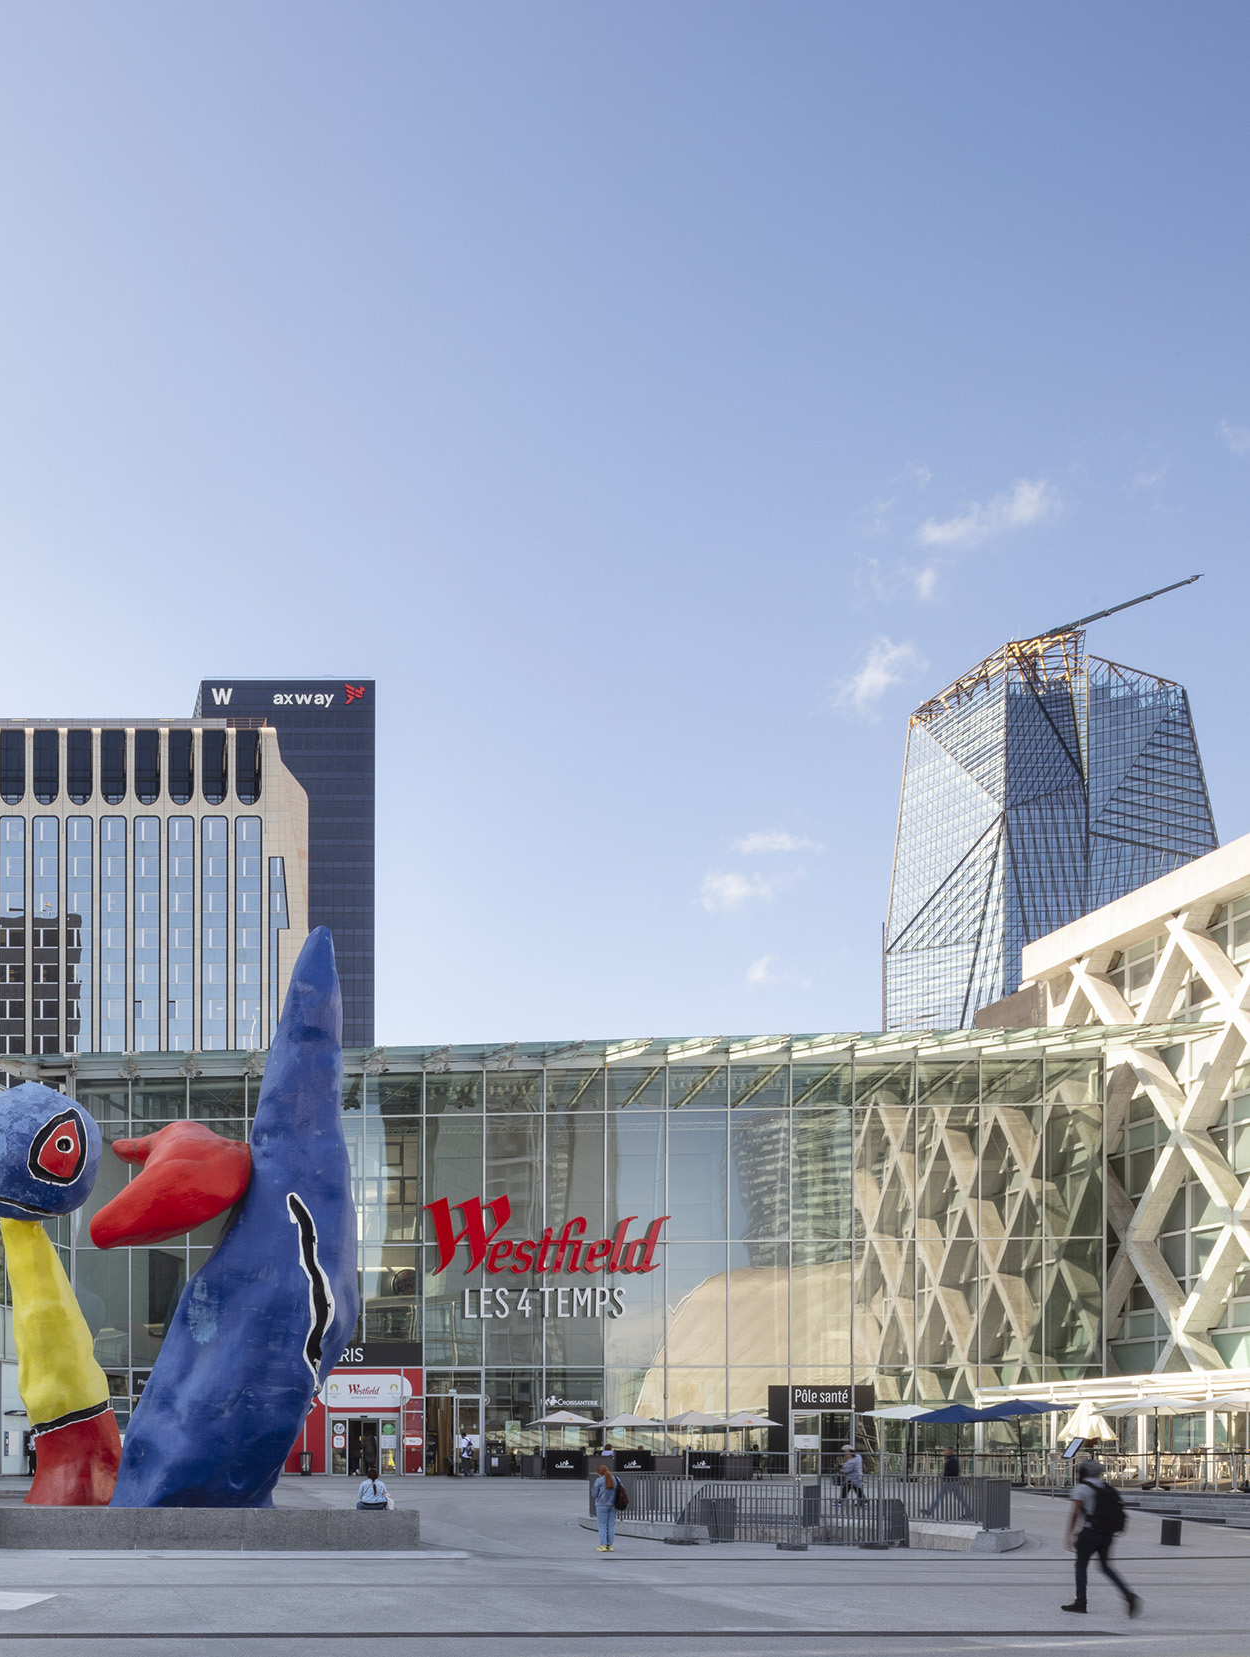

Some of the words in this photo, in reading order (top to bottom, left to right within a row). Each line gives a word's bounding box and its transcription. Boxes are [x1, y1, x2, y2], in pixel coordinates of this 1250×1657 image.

[211, 687, 233, 706] W
[273, 693, 334, 708] axway
[422, 1194, 671, 1274] Westfield
[465, 1288, 510, 1318] LES
[517, 1287, 532, 1318] 4
[539, 1287, 627, 1319] TEMPS
[338, 1347, 364, 1362] RIS
[348, 1383, 380, 1395] Westfield
[795, 1389, 817, 1403] Pôle
[820, 1389, 848, 1403] santé
